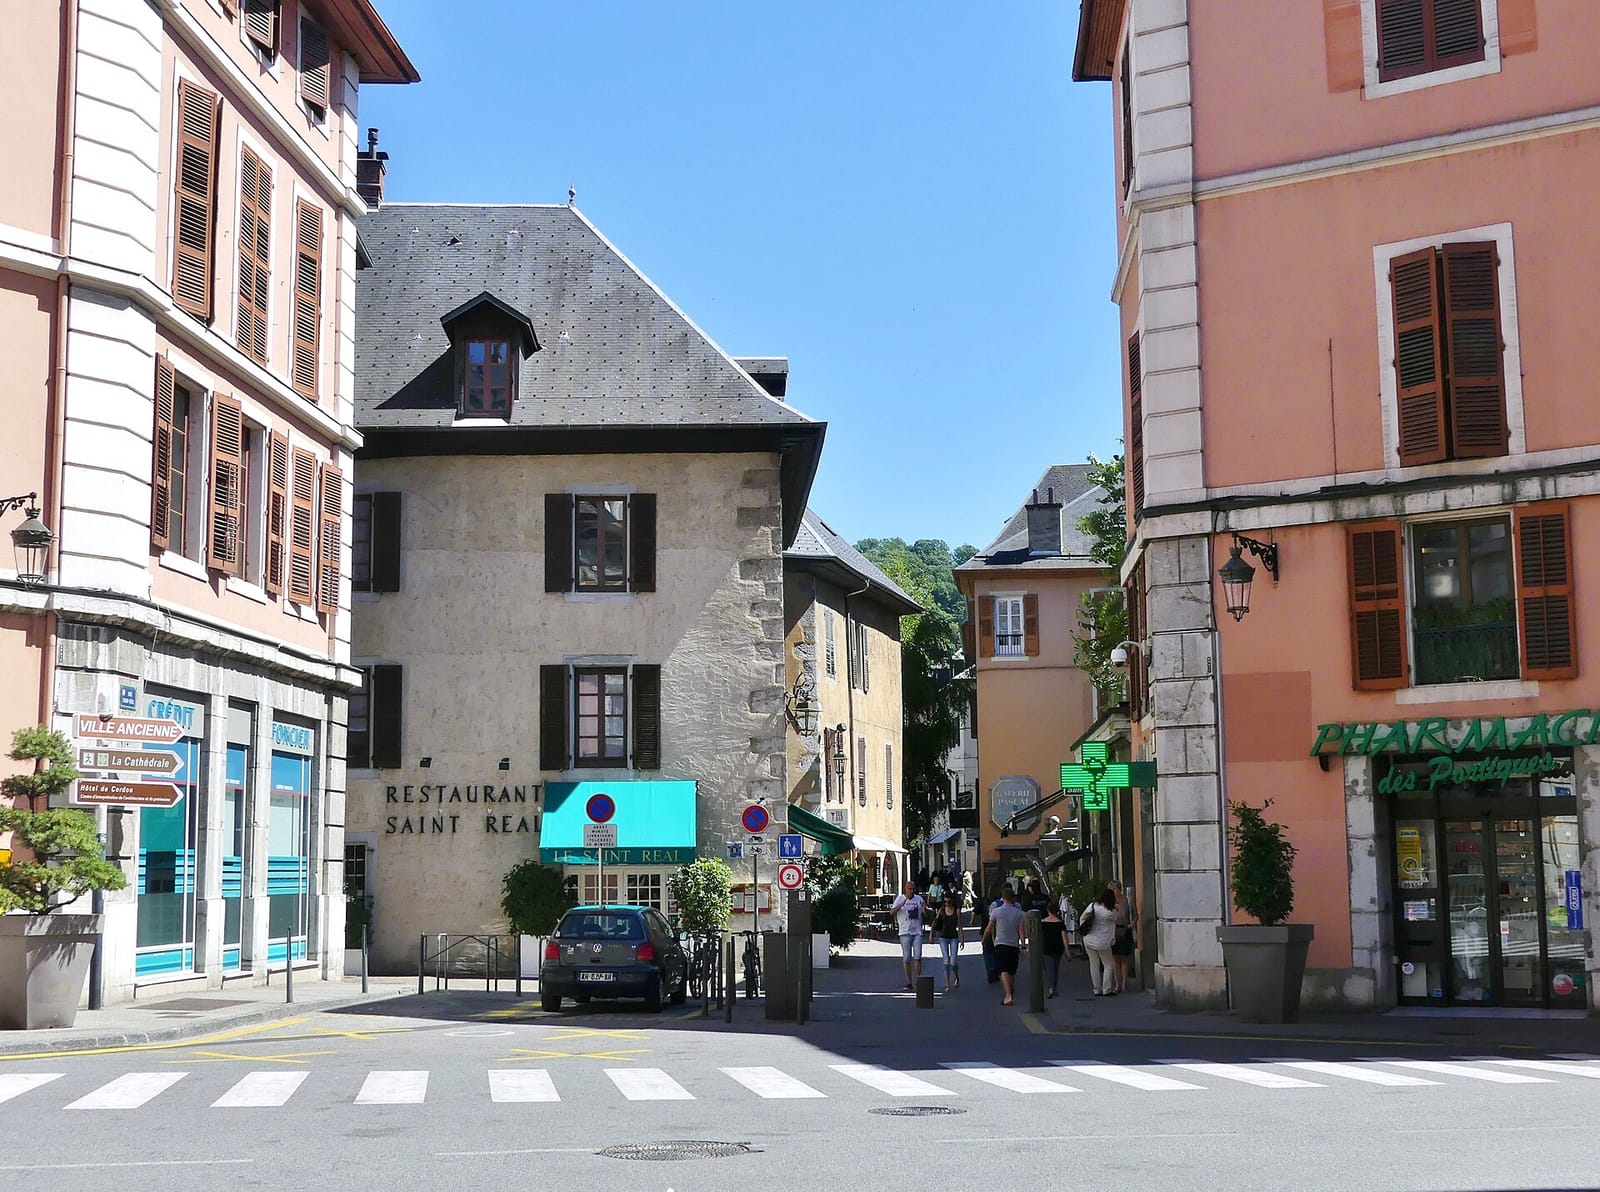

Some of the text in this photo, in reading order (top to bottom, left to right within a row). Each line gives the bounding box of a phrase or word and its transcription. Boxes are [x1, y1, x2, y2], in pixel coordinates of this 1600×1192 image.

[147, 697, 195, 727] CRÉDIT
[80, 719, 178, 738] VILLE ANCIENNE
[272, 722, 310, 750] FONCIER
[112, 755, 170, 768] La Cathédrale
[1378, 752, 1556, 794] des Portiques
[386, 785, 543, 803] RESTAURANT
[386, 815, 460, 834] SAINT
[642, 849, 681, 862] REAL
